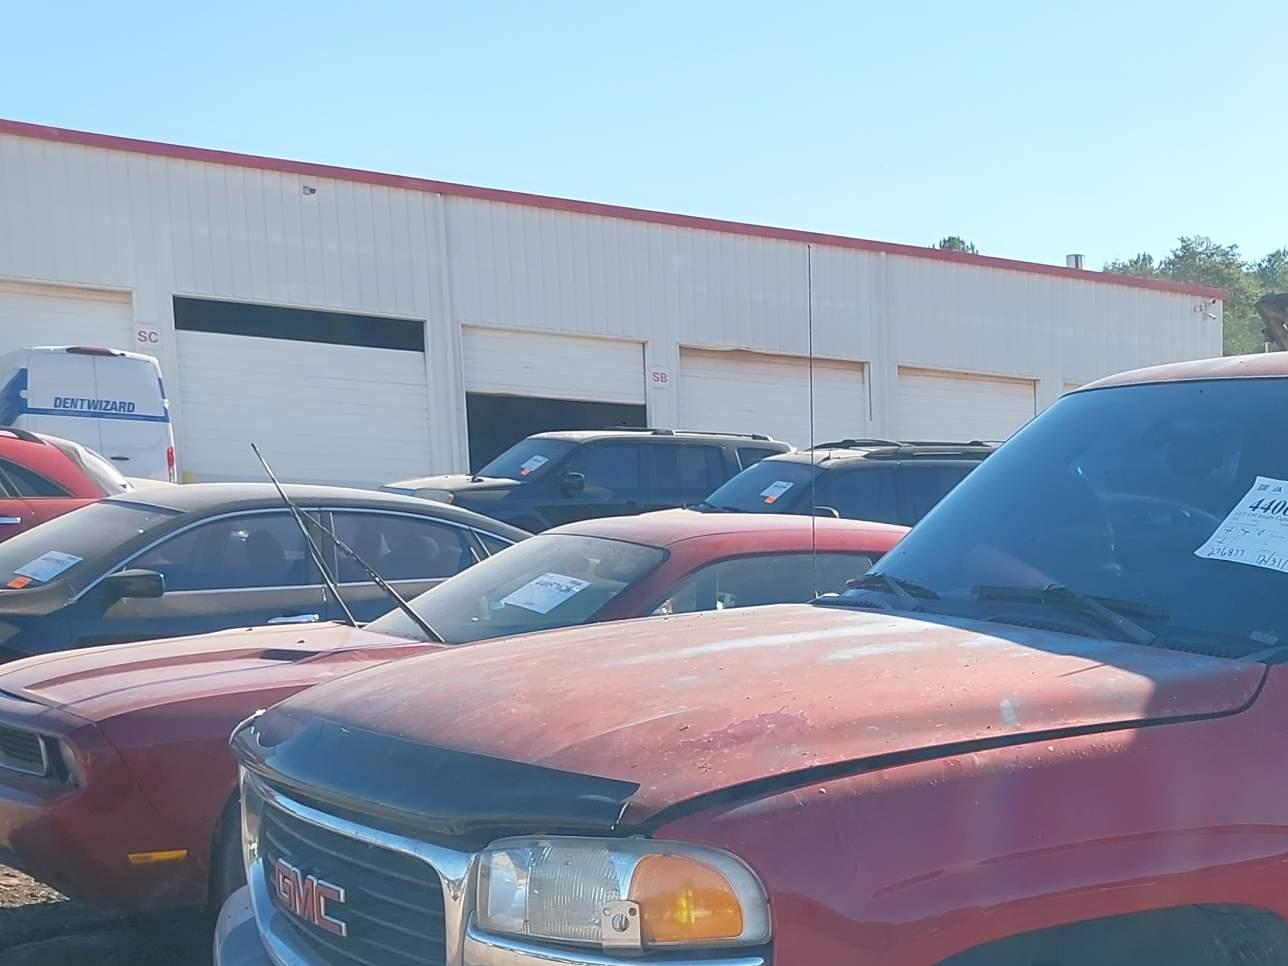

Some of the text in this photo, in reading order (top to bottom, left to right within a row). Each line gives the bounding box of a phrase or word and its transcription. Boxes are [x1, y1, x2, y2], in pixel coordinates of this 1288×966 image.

[138, 331, 159, 343] SC
[652, 371, 668, 383] SB
[275, 857, 347, 937] GMC
